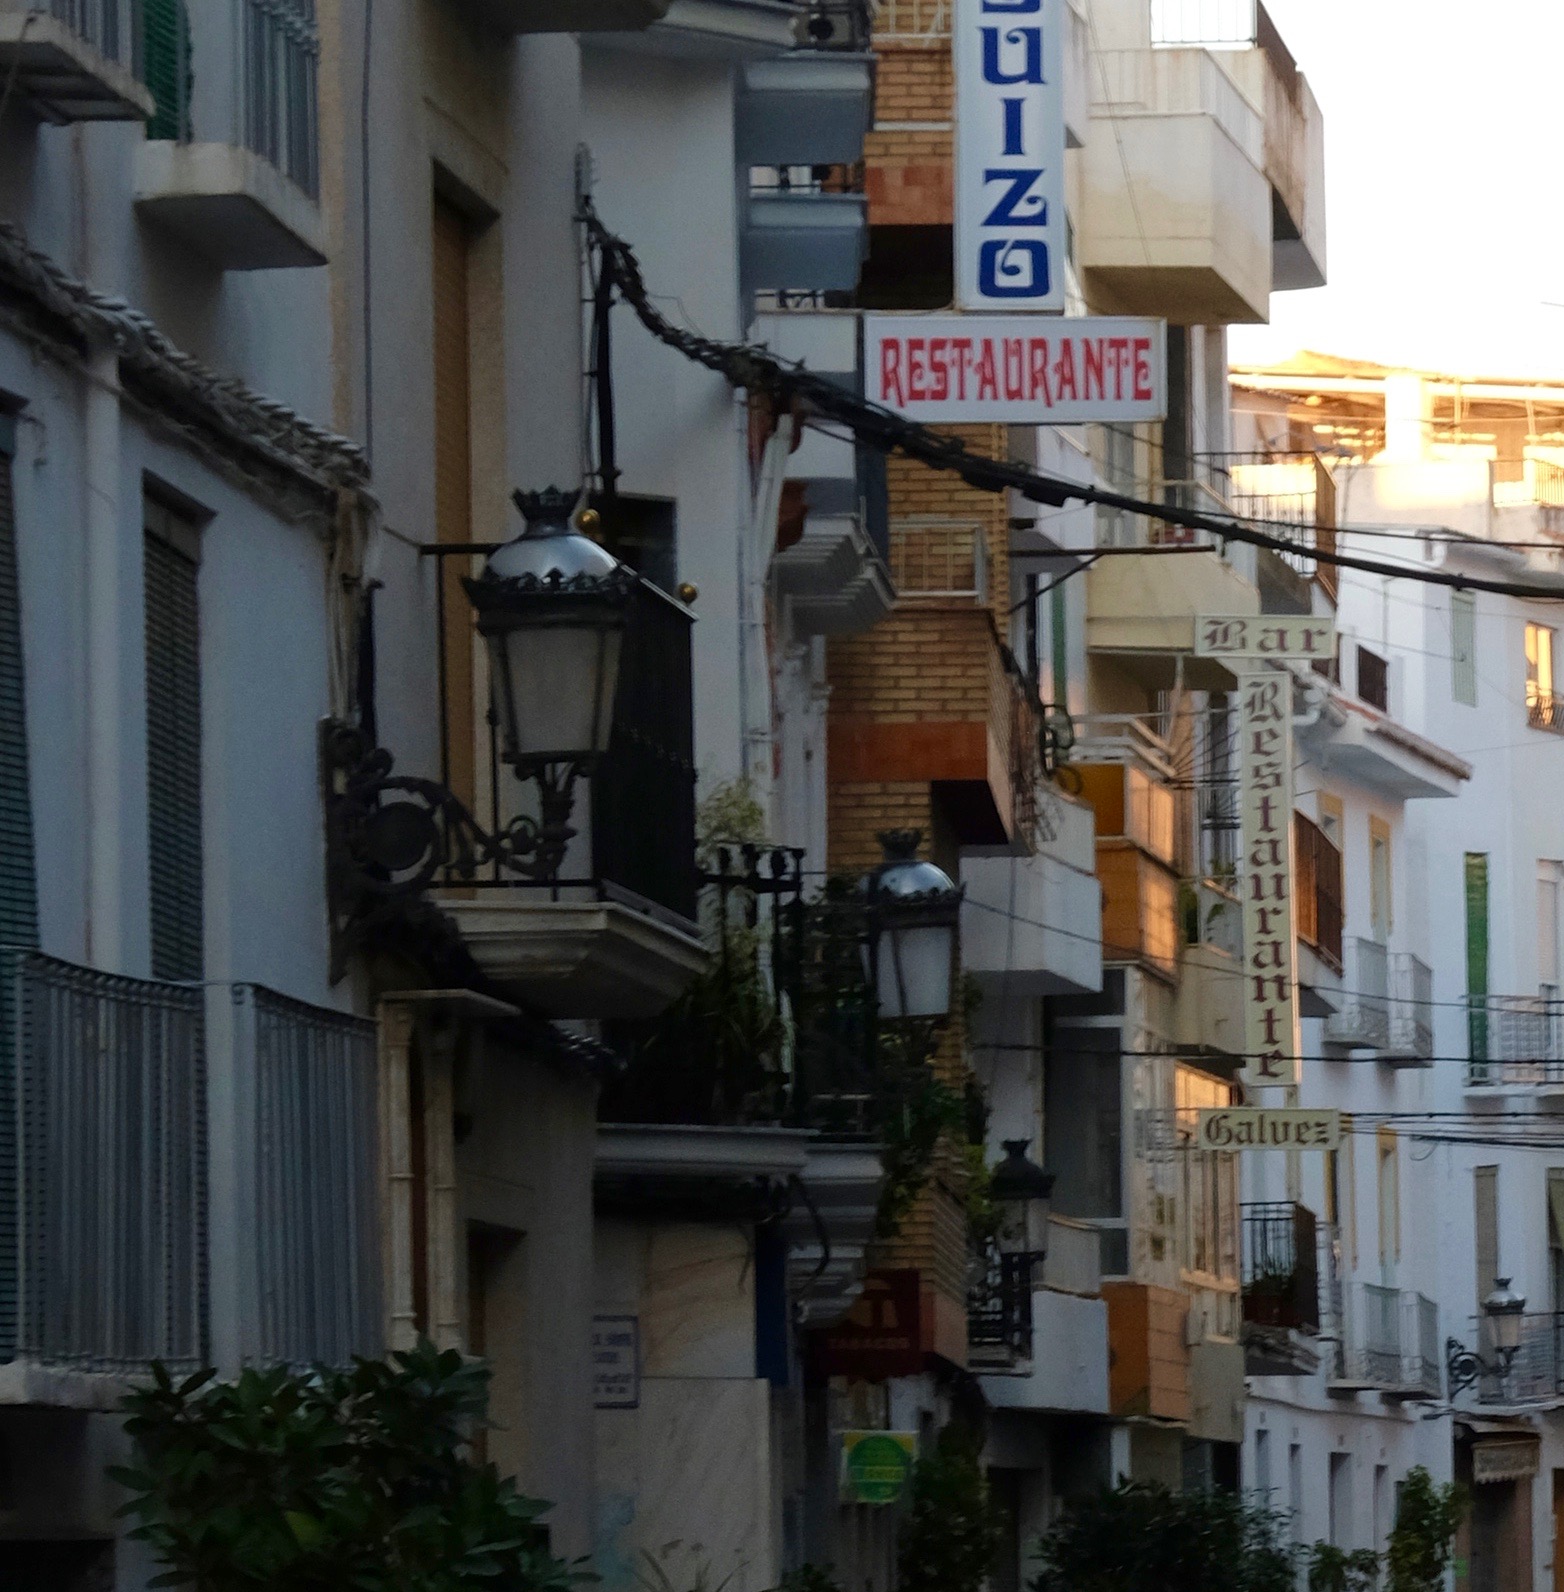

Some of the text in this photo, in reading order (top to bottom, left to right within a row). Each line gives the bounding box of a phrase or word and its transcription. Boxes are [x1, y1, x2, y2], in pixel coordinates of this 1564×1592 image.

[977, 0, 1051, 298] UIZO
[879, 337, 1153, 407] RESTAURANTE
[1204, 619, 1330, 654] Bar
[1243, 681, 1292, 1079] Restaurante
